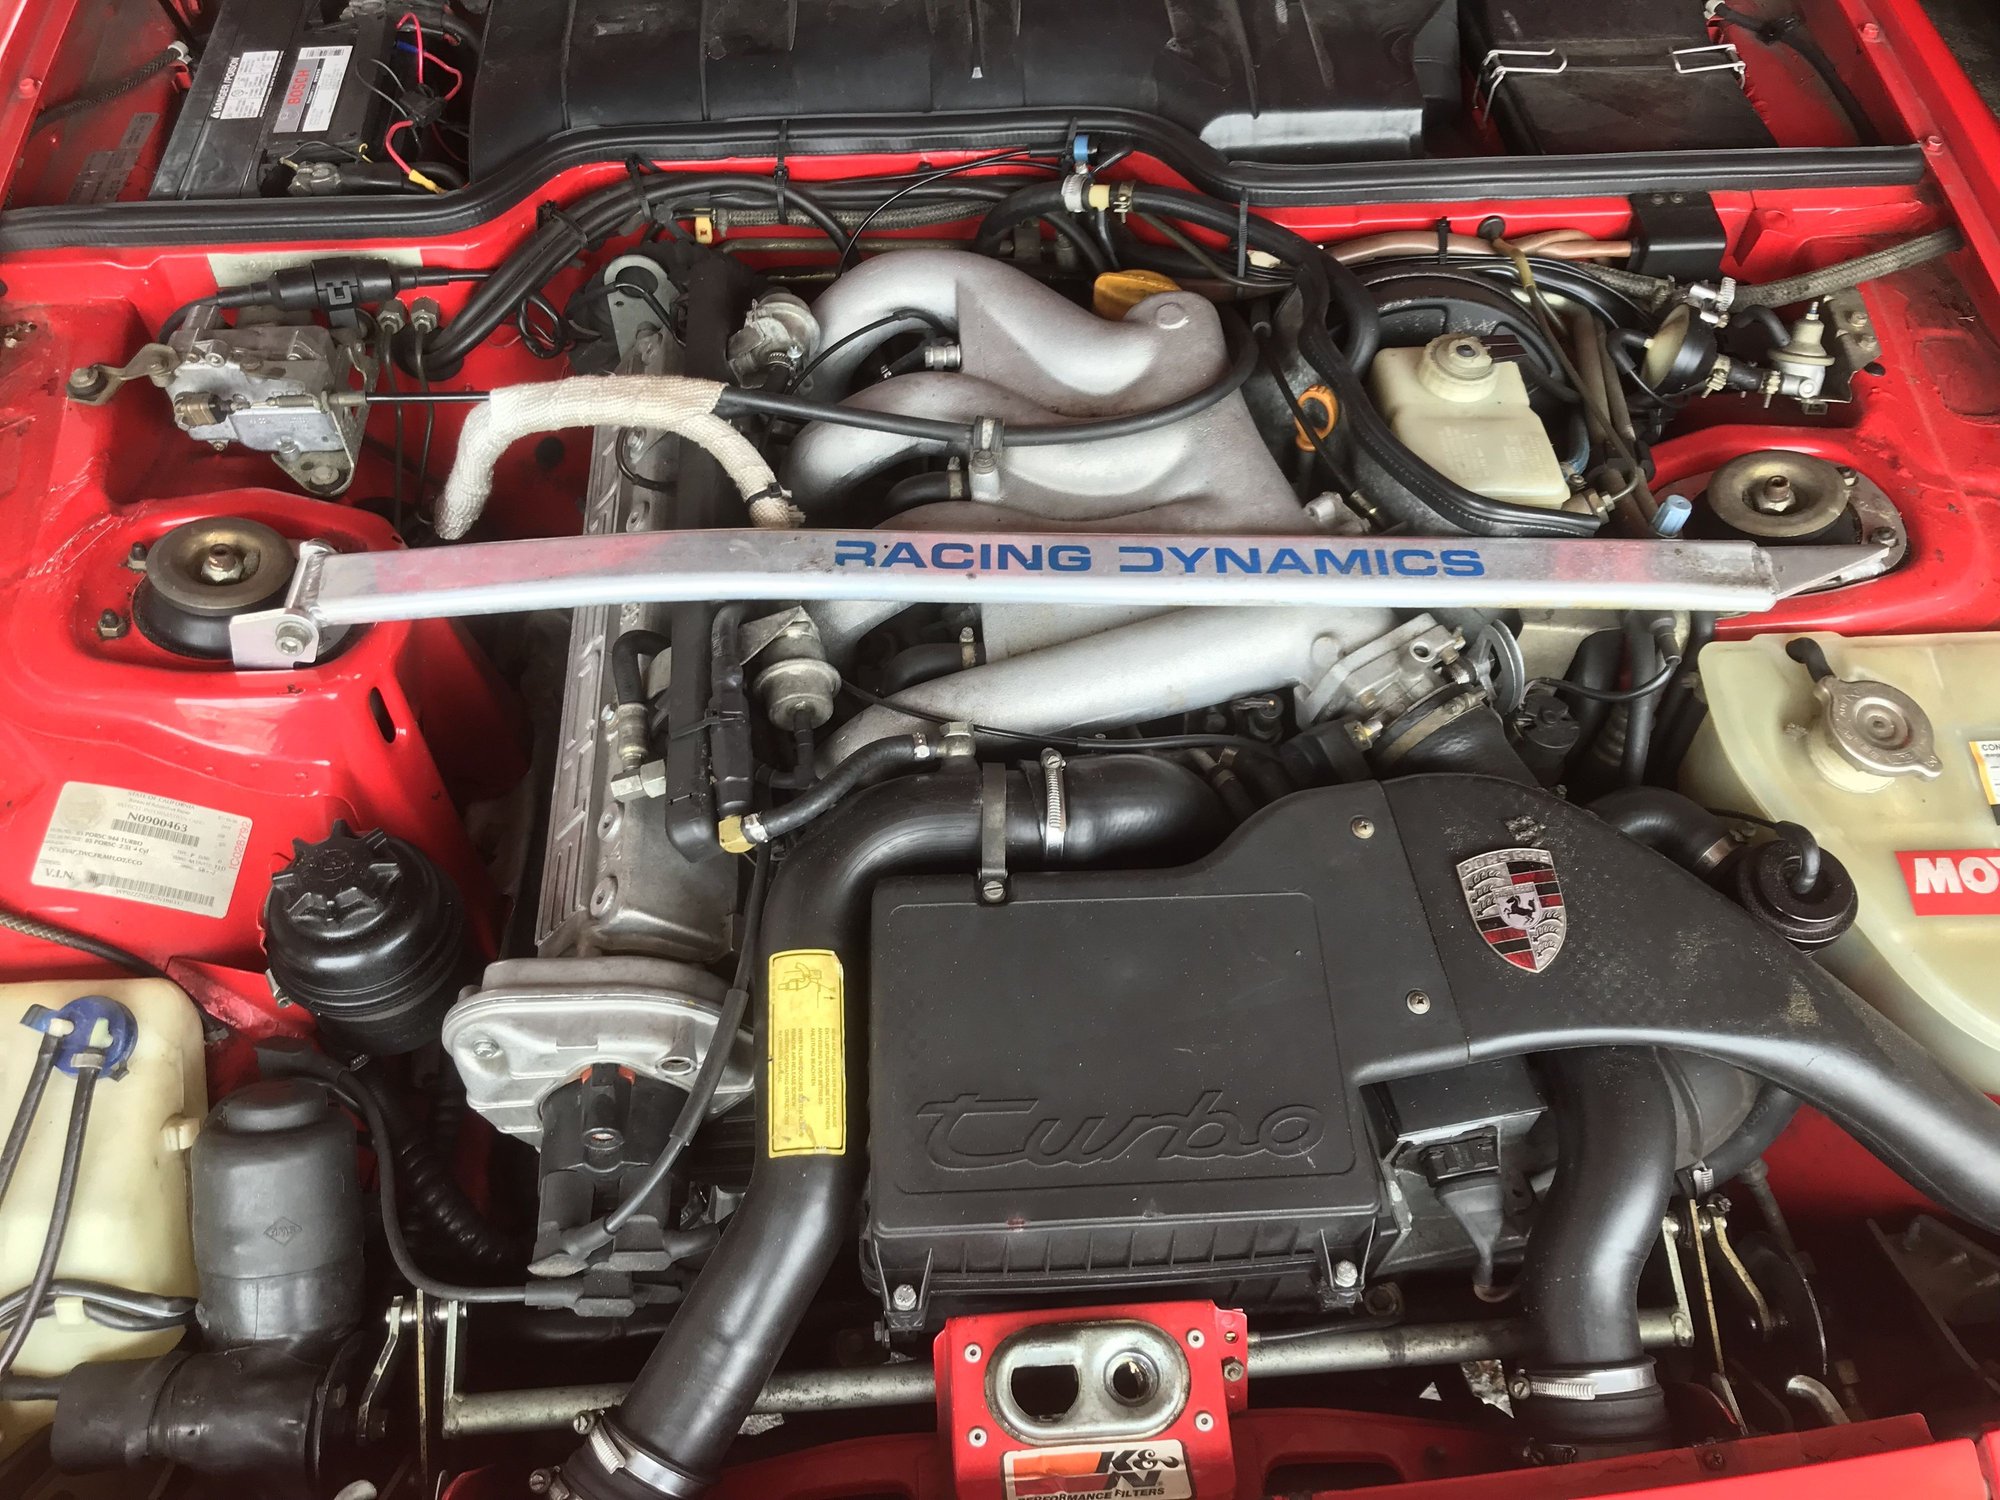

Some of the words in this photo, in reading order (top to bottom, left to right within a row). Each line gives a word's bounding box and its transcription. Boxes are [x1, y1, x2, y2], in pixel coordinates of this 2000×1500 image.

[287, 69, 311, 106] BOSCH
[836, 540, 1093, 573] RACING
[1119, 546, 1485, 577] DYNAMICS
[127, 811, 189, 833] N0900463
[1462, 851, 1550, 873] PORSCHE
[916, 1090, 1326, 1172] turbo
[1017, 1491, 1113, 1500] FORMANCE
[1114, 1487, 1165, 1498] FILTERS
